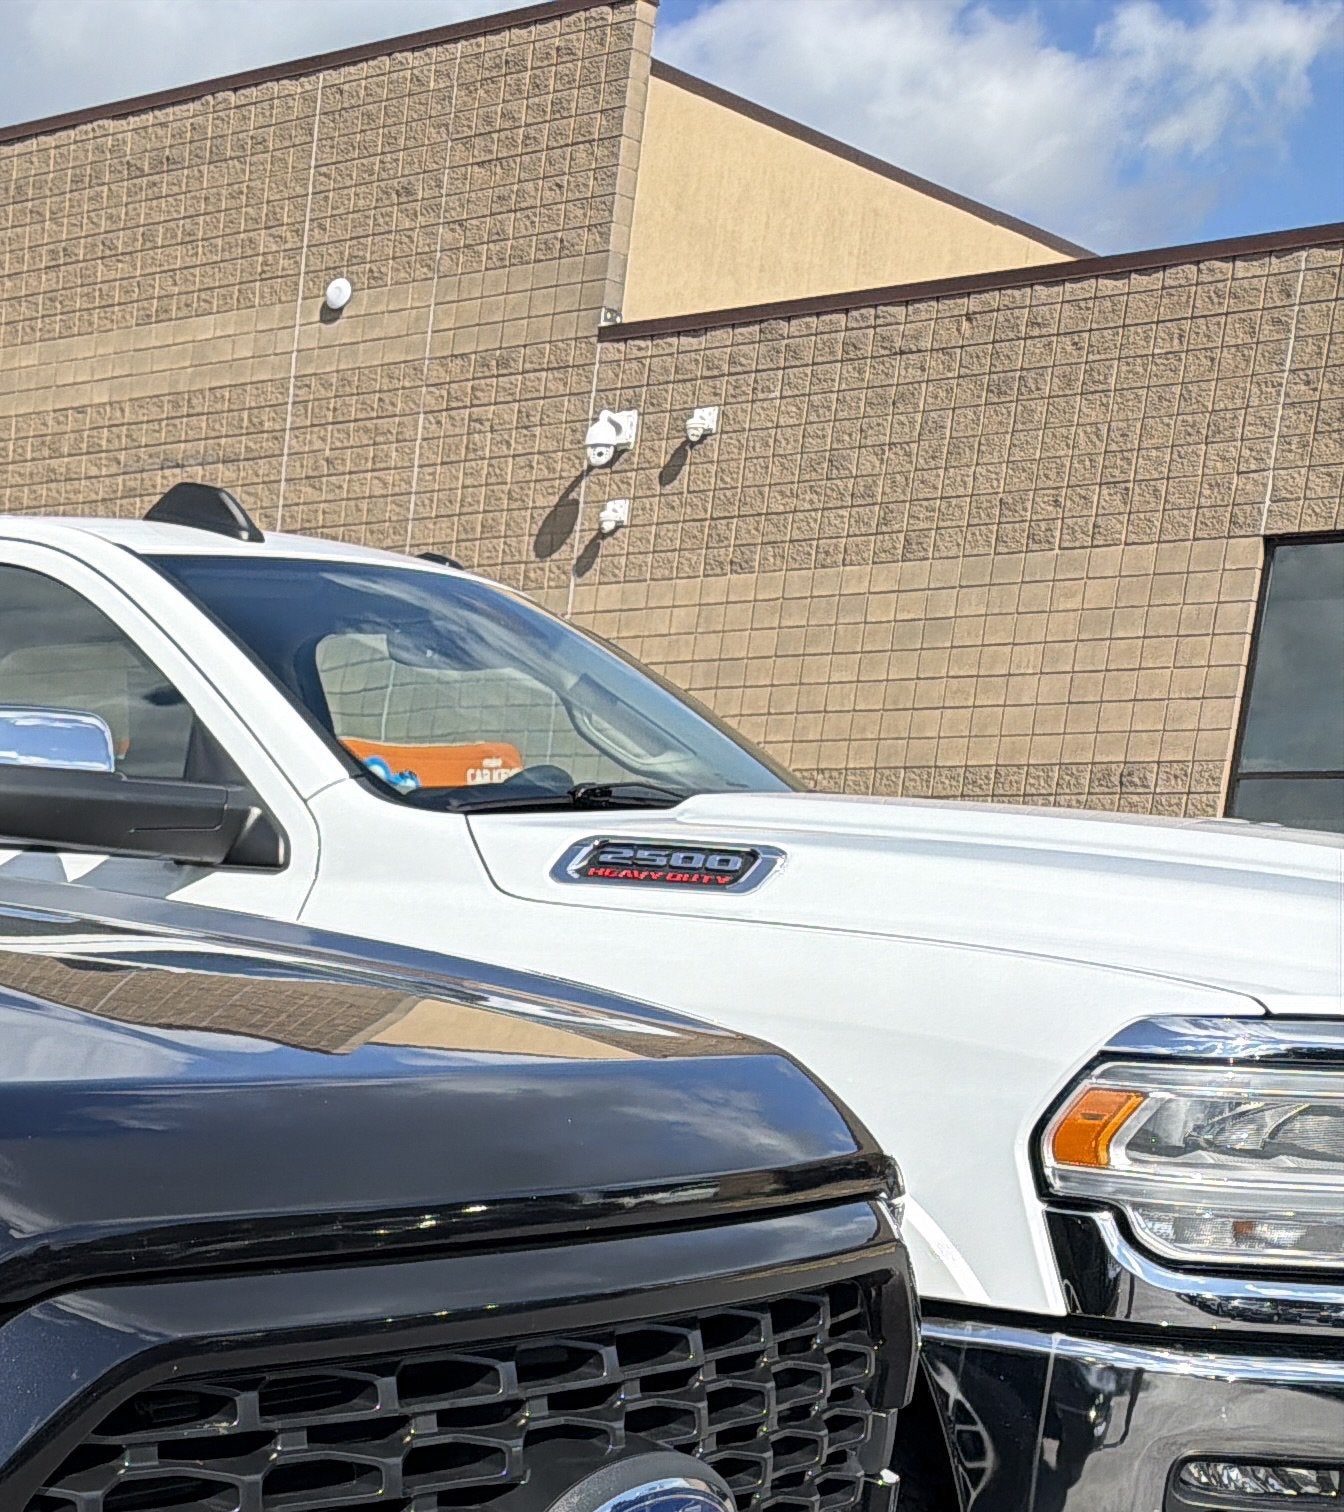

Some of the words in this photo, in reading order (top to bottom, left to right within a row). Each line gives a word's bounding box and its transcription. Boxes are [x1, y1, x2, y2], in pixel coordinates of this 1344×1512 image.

[598, 847, 742, 872] 2500
[587, 867, 664, 881] HEAVY
[665, 871, 734, 884] DUTY
